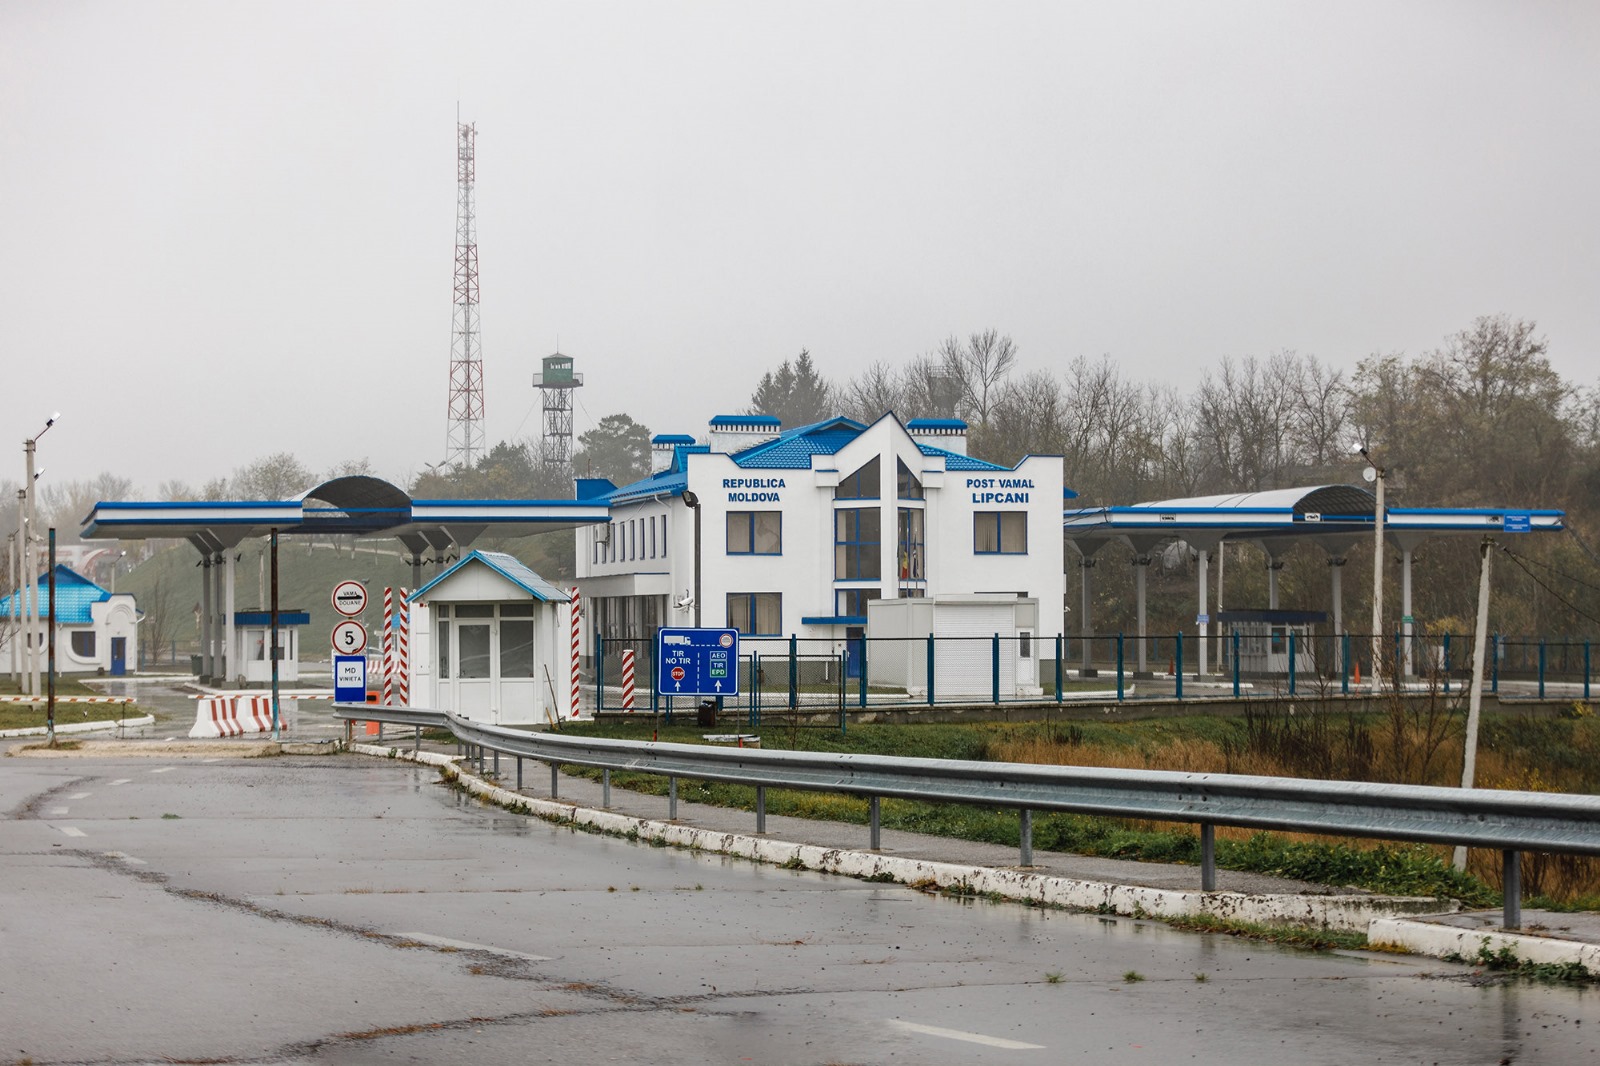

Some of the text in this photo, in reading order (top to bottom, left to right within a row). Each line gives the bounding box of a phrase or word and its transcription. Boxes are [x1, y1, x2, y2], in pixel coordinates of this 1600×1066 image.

[722, 478, 786, 488] REPUBLICA
[966, 478, 1035, 488] POST VAMAL
[728, 492, 780, 502] MOLDOVA
[972, 493, 1029, 503] LIPCANI
[345, 631, 354, 645] 5
